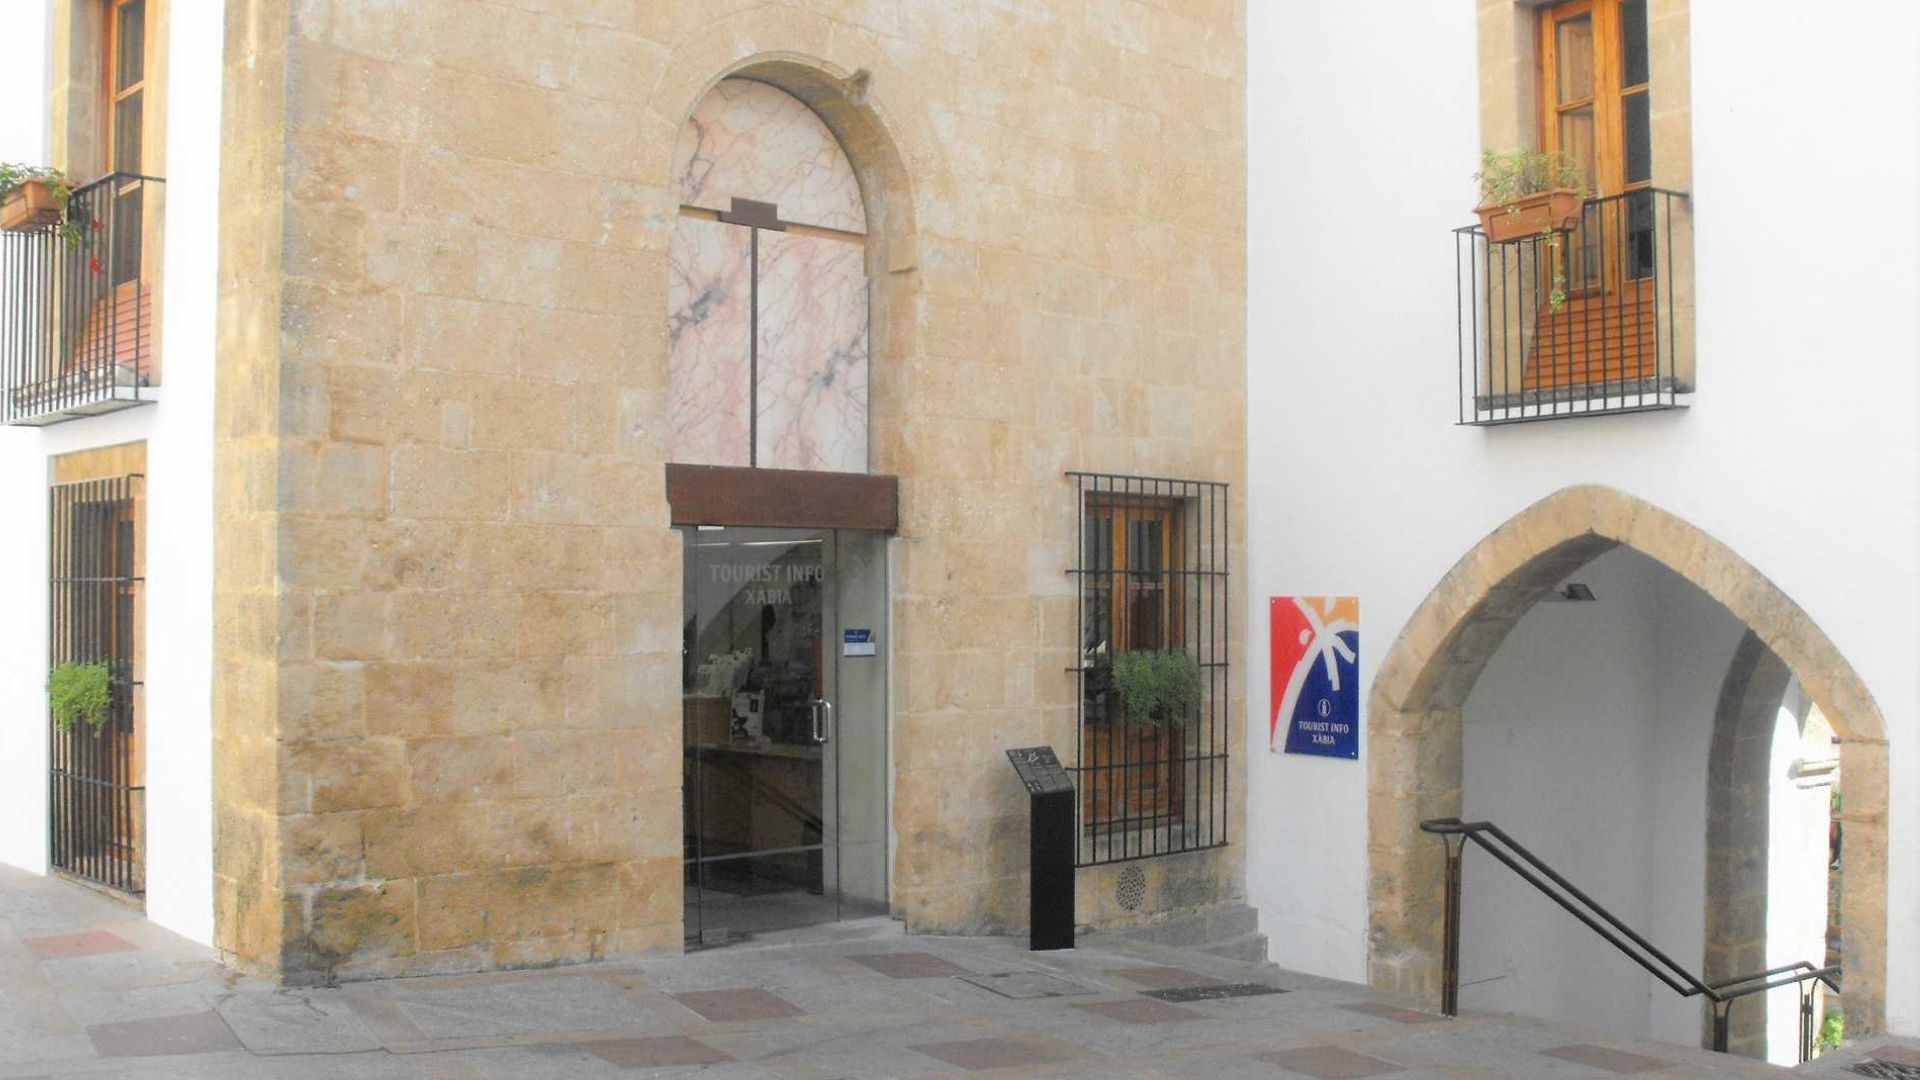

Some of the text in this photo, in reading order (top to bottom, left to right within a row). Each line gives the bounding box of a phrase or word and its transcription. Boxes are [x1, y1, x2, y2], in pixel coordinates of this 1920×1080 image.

[709, 564, 825, 582] TOURIST INFO
[1299, 720, 1350, 734] TOURIST INFO
